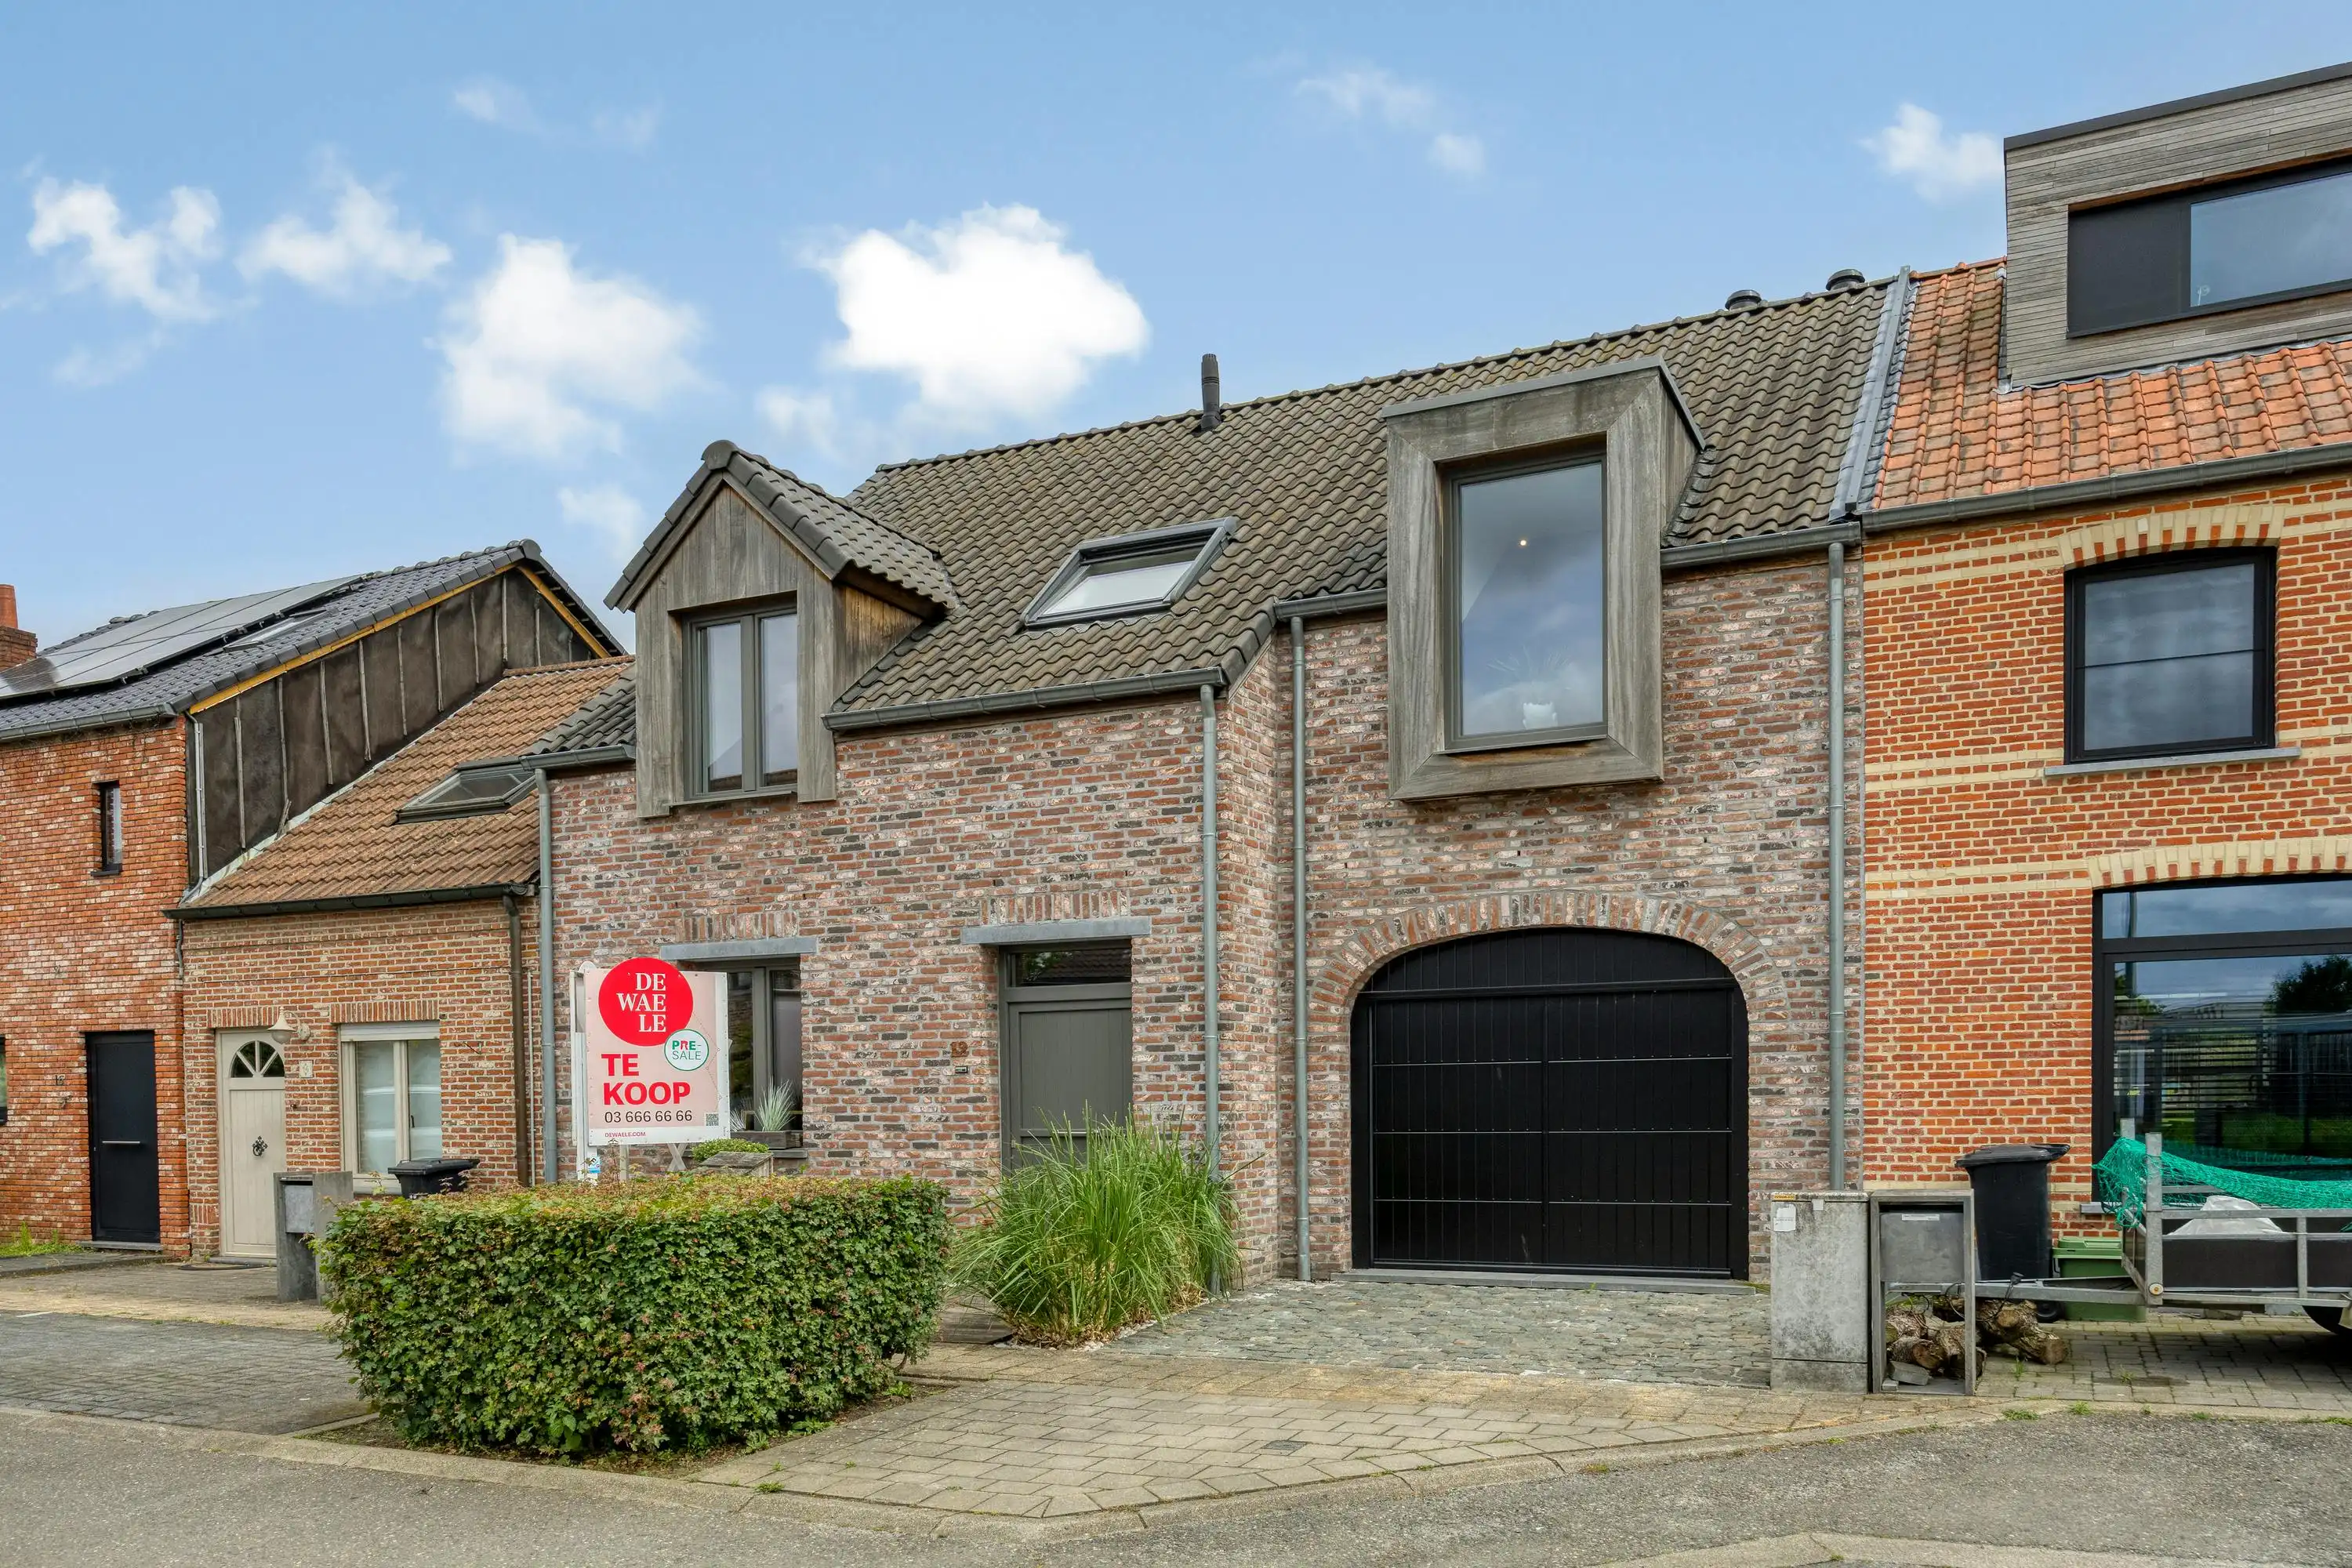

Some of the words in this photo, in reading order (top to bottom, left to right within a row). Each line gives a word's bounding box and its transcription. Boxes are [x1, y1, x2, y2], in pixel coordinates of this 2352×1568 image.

[635, 972, 666, 991] DE
[615, 993, 666, 1012] WAE
[638, 1014, 666, 1033] LE
[672, 1040, 702, 1051] PRE-
[601, 1053, 640, 1076] TE
[672, 1051, 702, 1061] SALE
[603, 1081, 691, 1105] KOOP
[604, 1111, 622, 1123] 03
[625, 1110, 652, 1123] 666
[655, 1110, 673, 1122] 66
[676, 1109, 693, 1121] 66
